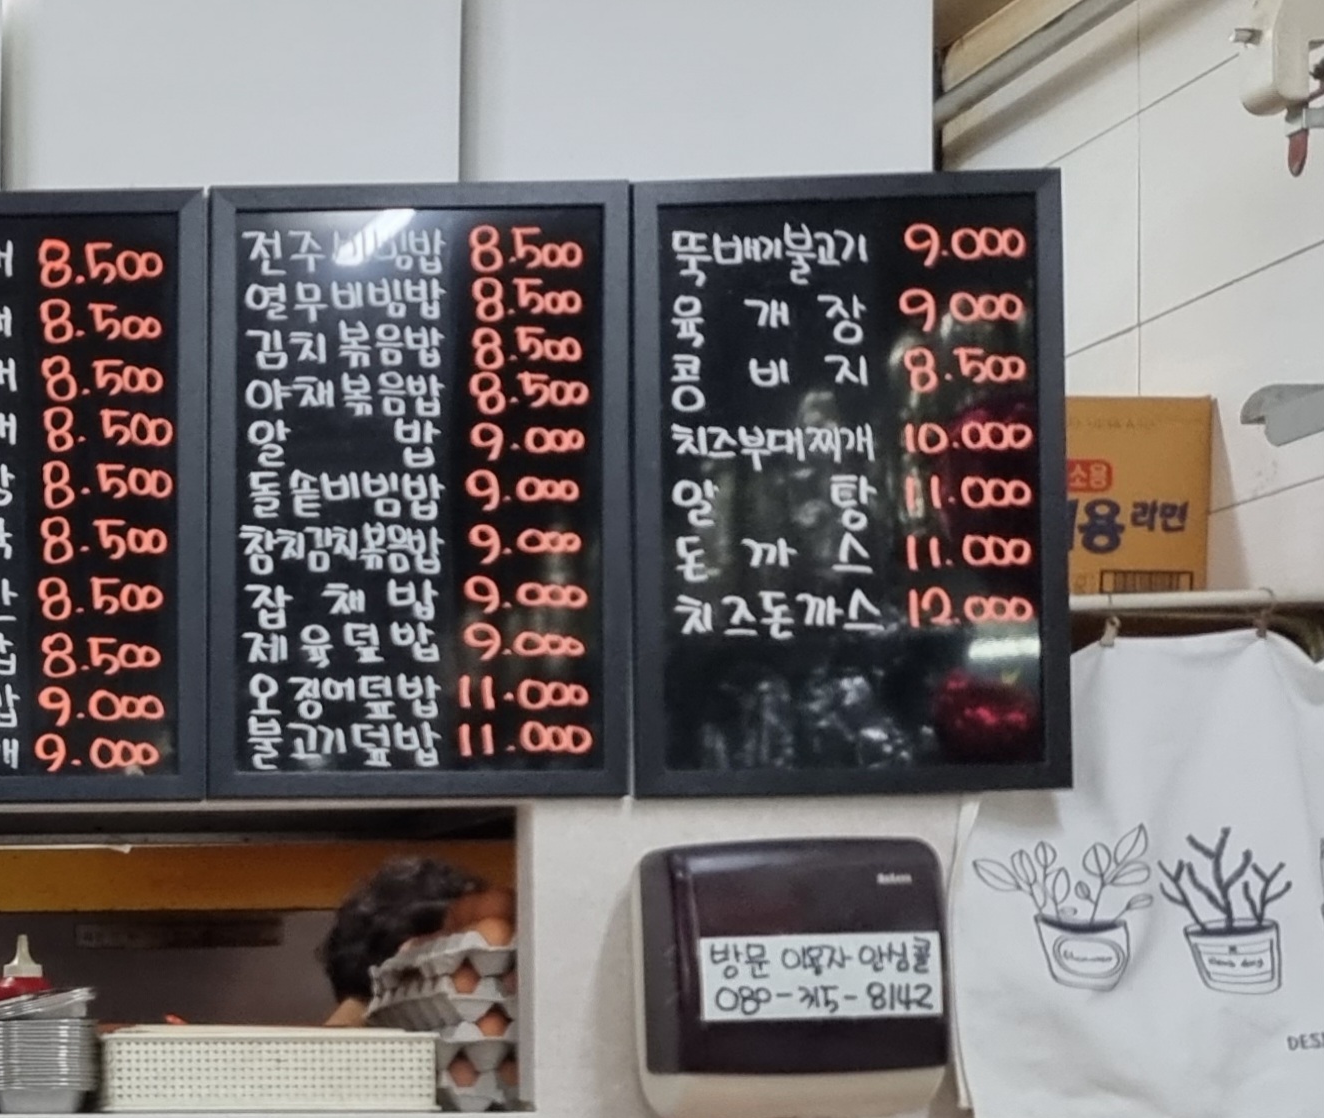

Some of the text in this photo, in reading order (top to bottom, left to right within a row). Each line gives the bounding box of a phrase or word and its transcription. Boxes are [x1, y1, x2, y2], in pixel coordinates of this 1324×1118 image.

[245, 276, 446, 322] 열무비빔밥
[245, 321, 446, 369] 김치볶음밥
[245, 372, 443, 416] 야채볶음밥
[671, 422, 875, 471] 치즈부대찌개
[249, 471, 445, 519] 돌솥비빔밥
[1068, 500, 1189, 555] 용 라면
[675, 588, 883, 639] 치즈돈까스
[243, 622, 440, 668] 제육덮밥
[247, 674, 440, 720] 오징어덮밥
[247, 716, 441, 769] 불고기덮밥
[709, 943, 770, 979] 방문
